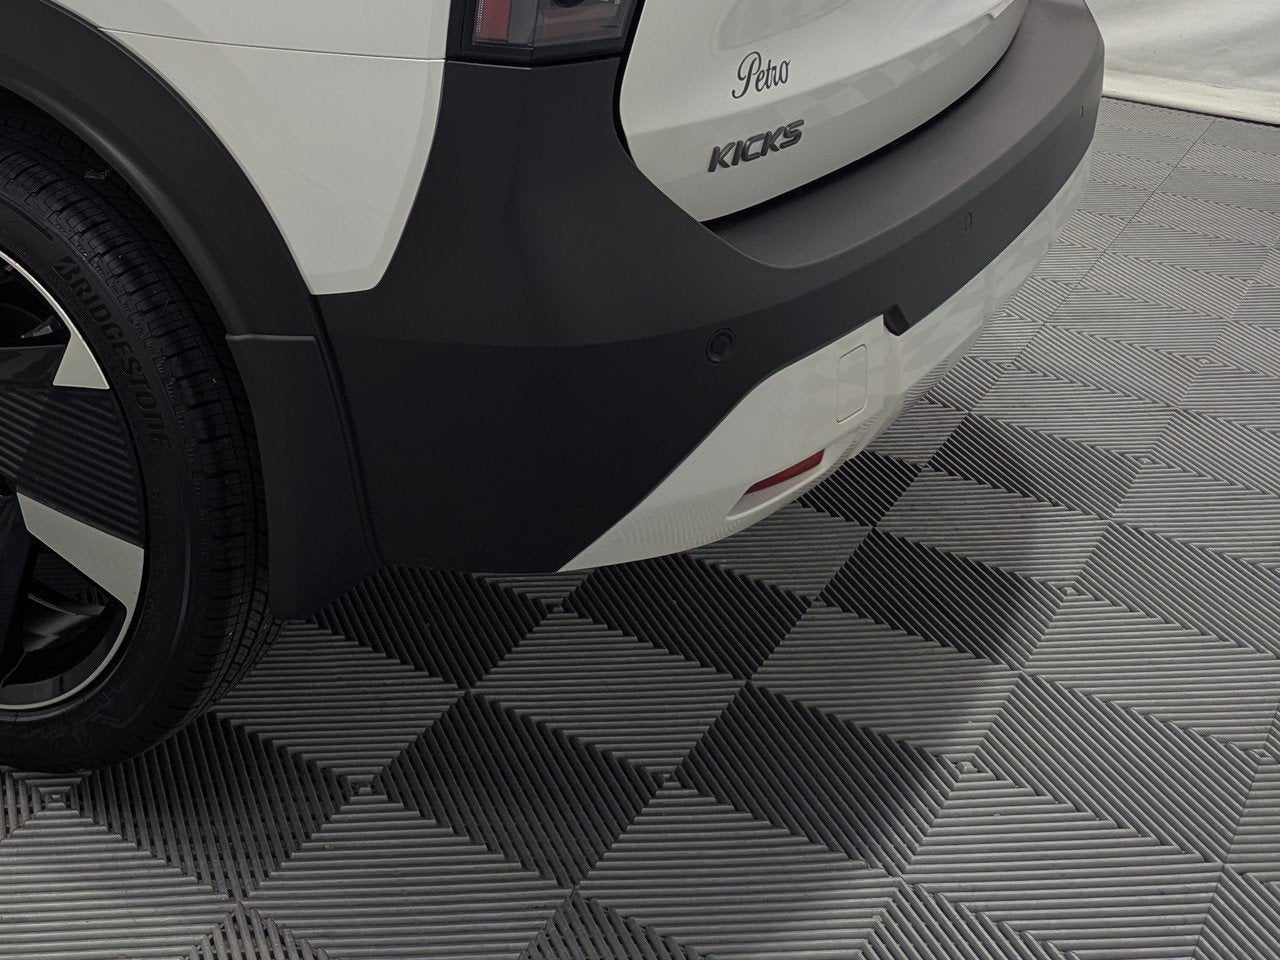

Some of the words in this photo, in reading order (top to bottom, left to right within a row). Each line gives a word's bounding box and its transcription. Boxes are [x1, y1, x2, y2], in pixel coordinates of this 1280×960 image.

[731, 51, 791, 99] Petro
[707, 119, 805, 173] KICKS
[51, 254, 172, 449] BRIDGESTONE
